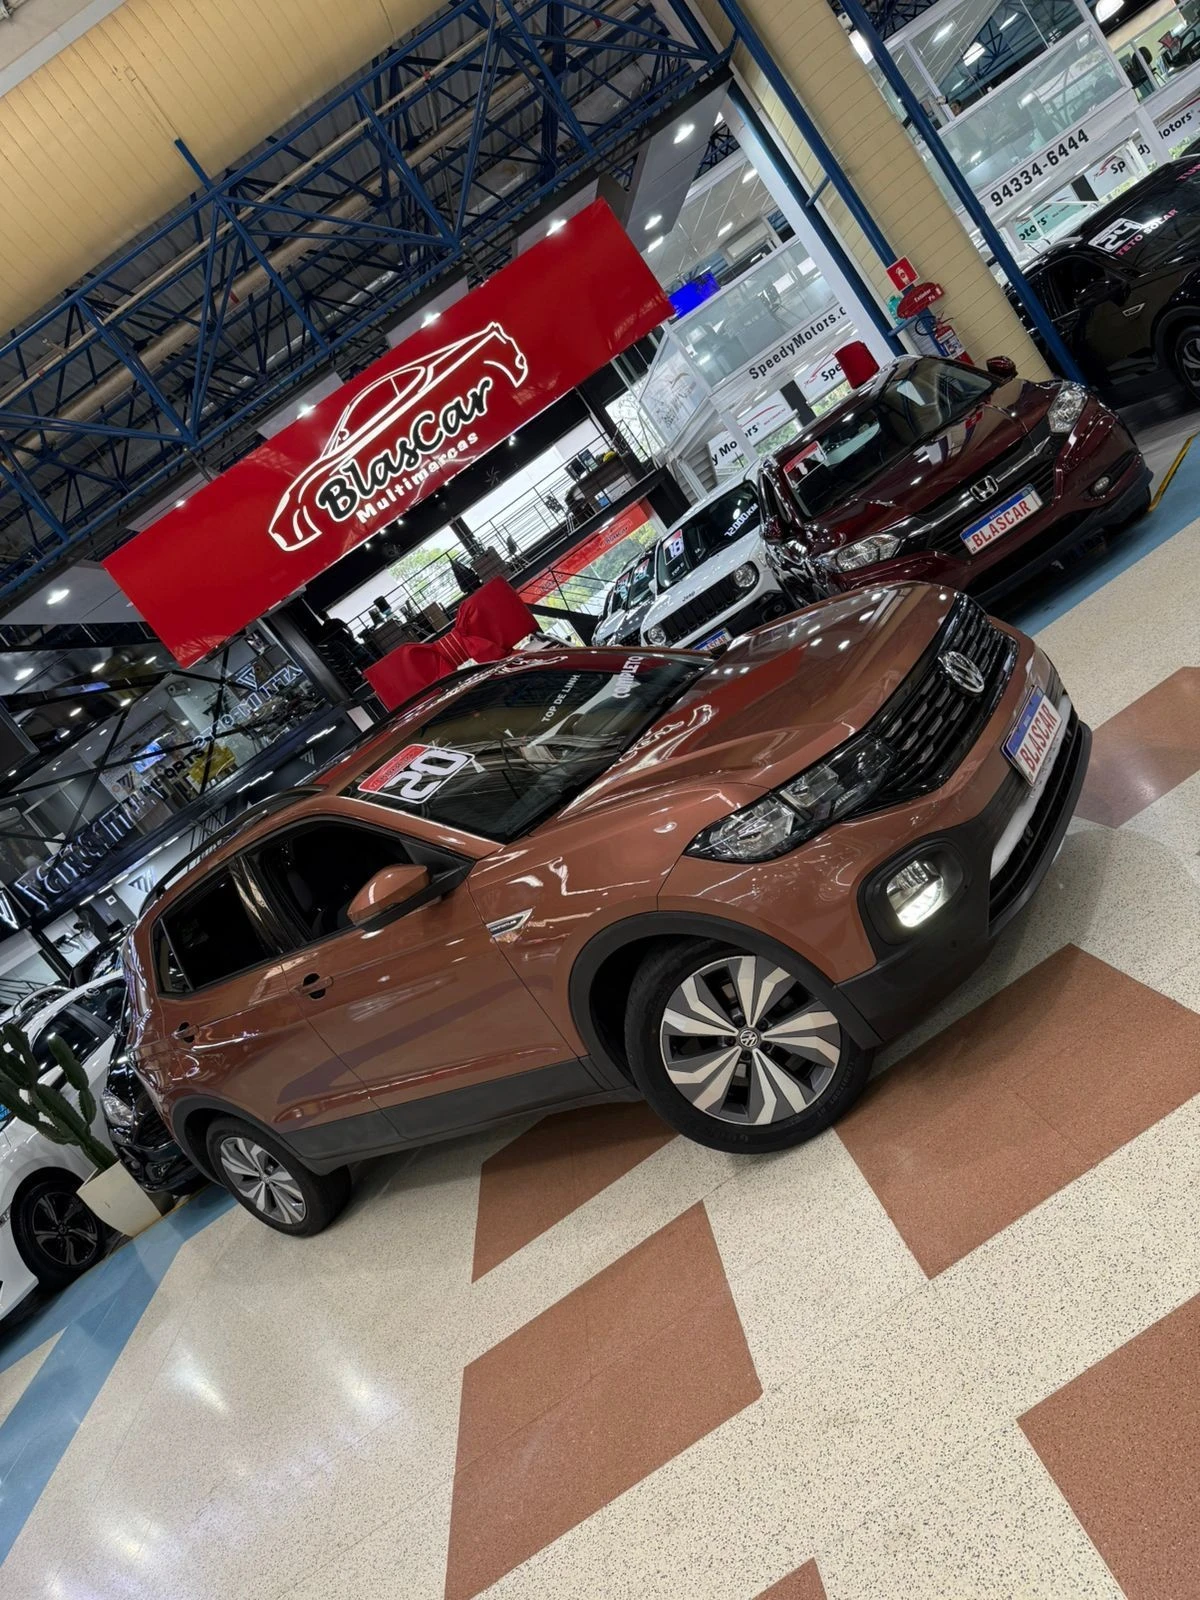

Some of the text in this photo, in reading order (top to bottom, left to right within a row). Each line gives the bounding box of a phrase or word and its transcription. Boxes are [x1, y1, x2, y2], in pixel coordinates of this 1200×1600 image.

[1158, 111, 1192, 140] otors
[990, 129, 1090, 207] 94334-6444
[1104, 221, 1143, 251] 24
[1115, 234, 1144, 257] TETO
[1143, 208, 1179, 236] SOLAR
[316, 376, 493, 523] BlasCar
[355, 431, 480, 525] Multimarcas
[971, 500, 1032, 548] BLASCAR
[611, 655, 645, 699] COMPLETO
[541, 702, 556, 723] TOP
[555, 691, 567, 706] DE
[1020, 703, 1058, 773] BLASCAR
[384, 749, 469, 801] 20
